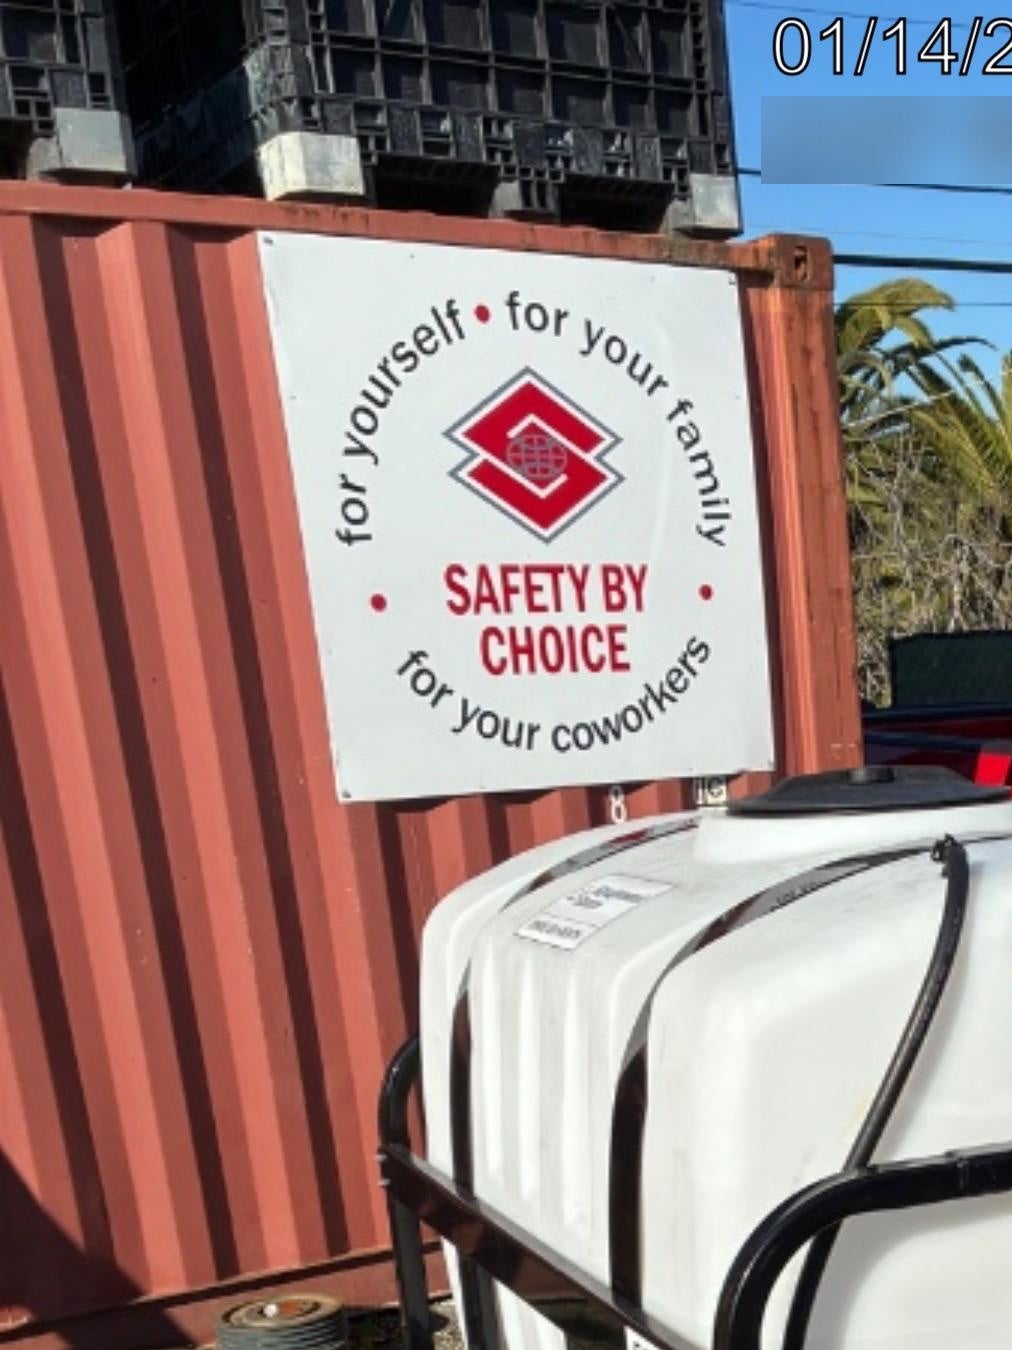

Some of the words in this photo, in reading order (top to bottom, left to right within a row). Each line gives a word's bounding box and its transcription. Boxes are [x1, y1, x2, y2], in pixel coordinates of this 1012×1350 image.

[341, 299, 467, 466] yourself
[505, 290, 569, 336] for
[579, 320, 669, 397] your
[667, 399, 731, 547] family
[336, 473, 373, 547] for
[443, 563, 589, 616] SAFETY
[601, 563, 648, 613] BY
[397, 650, 454, 708] for
[451, 698, 541, 752] your
[551, 636, 711, 754] coworkers
[480, 623, 631, 676] CHOICE
